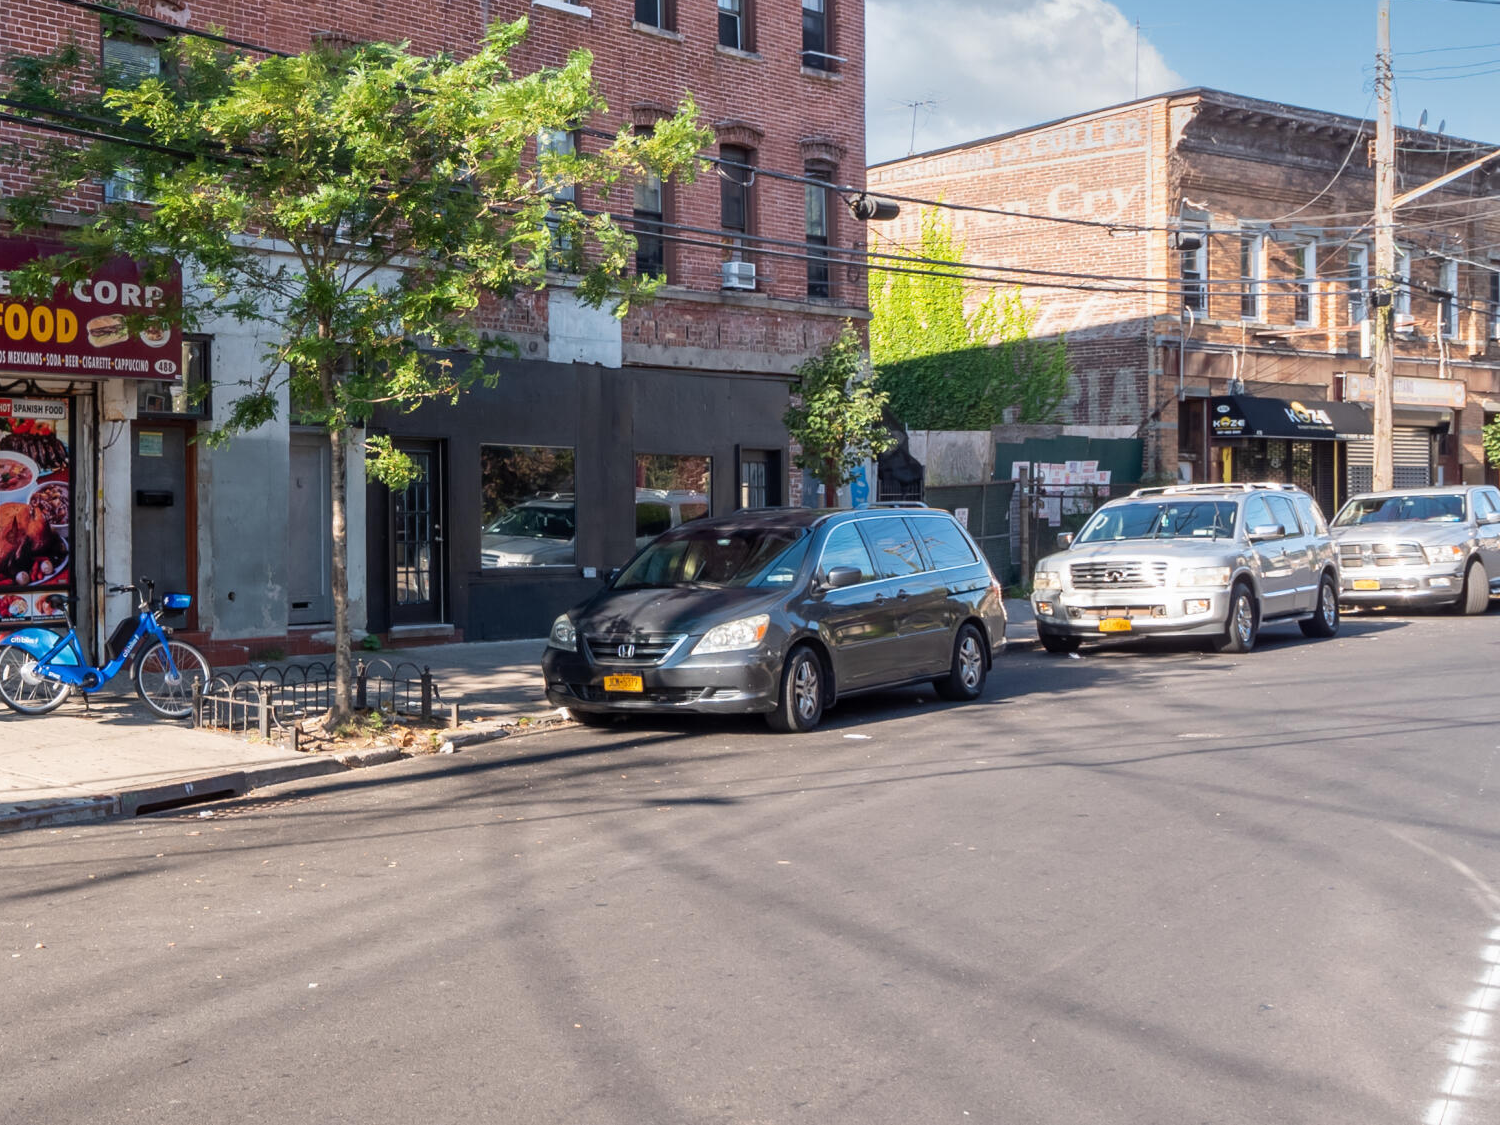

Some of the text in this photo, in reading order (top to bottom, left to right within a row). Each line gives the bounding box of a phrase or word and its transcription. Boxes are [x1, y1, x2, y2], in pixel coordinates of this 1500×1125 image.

[7, 350, 43, 366] MEXICANOS
[46, 354, 62, 367] SODA
[64, 355, 79, 368] BEER
[82, 356, 111, 370] CIGARETTE
[114, 357, 149, 372] CAPPUCCINO
[158, 361, 173, 374] 488
[13, 403, 43, 414] SPANISH
[45, 405, 64, 415] FOOD
